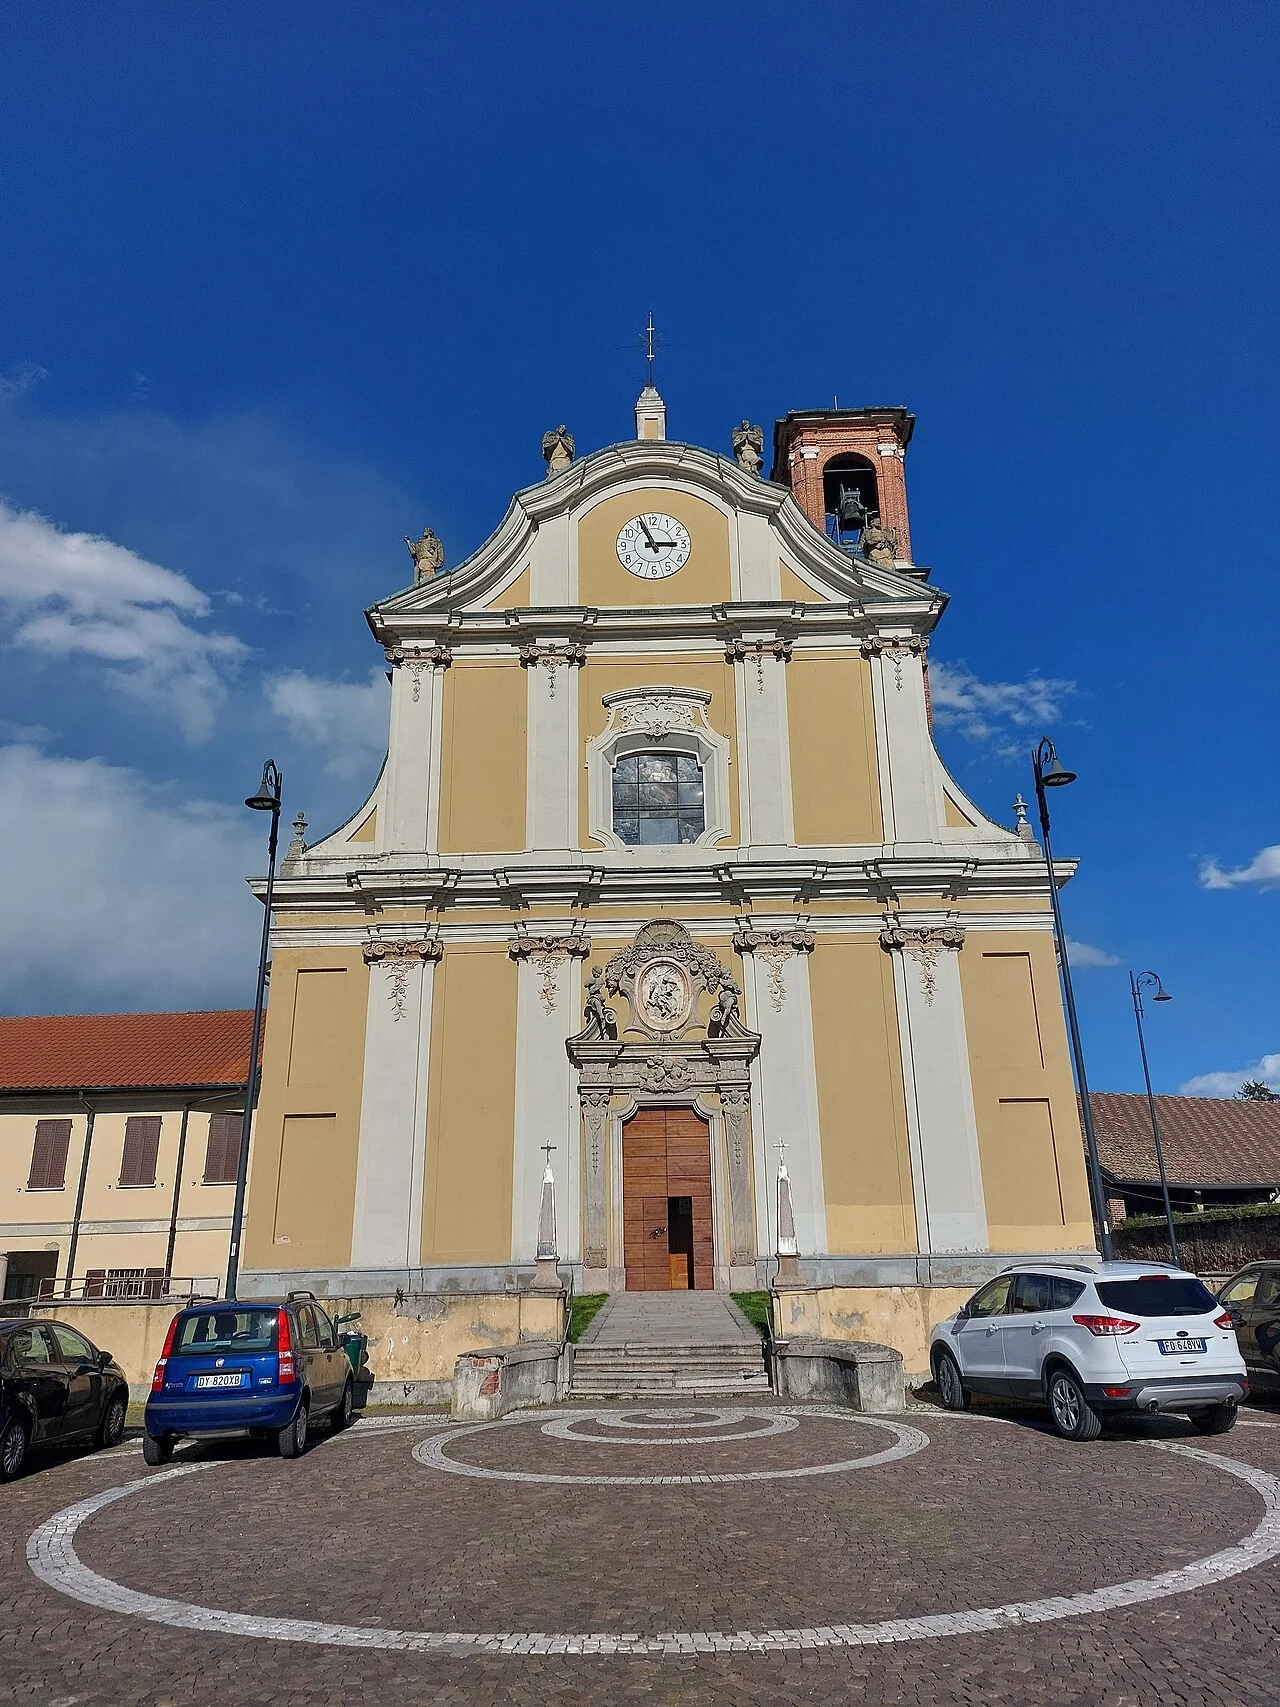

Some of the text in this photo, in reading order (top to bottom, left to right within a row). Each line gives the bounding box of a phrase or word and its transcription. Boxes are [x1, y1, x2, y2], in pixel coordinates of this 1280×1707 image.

[648, 516, 658, 526] 12
[624, 528, 634, 539] 10
[675, 526, 682, 537] 2
[620, 541, 627, 551] 9
[680, 539, 687, 549] 3
[625, 554, 632, 564] 8
[676, 553, 683, 563] 4
[637, 562, 644, 573] 7
[651, 565, 658, 575] 6
[664, 561, 672, 572] 5
[198, 1375, 240, 1387] DY 820XB
